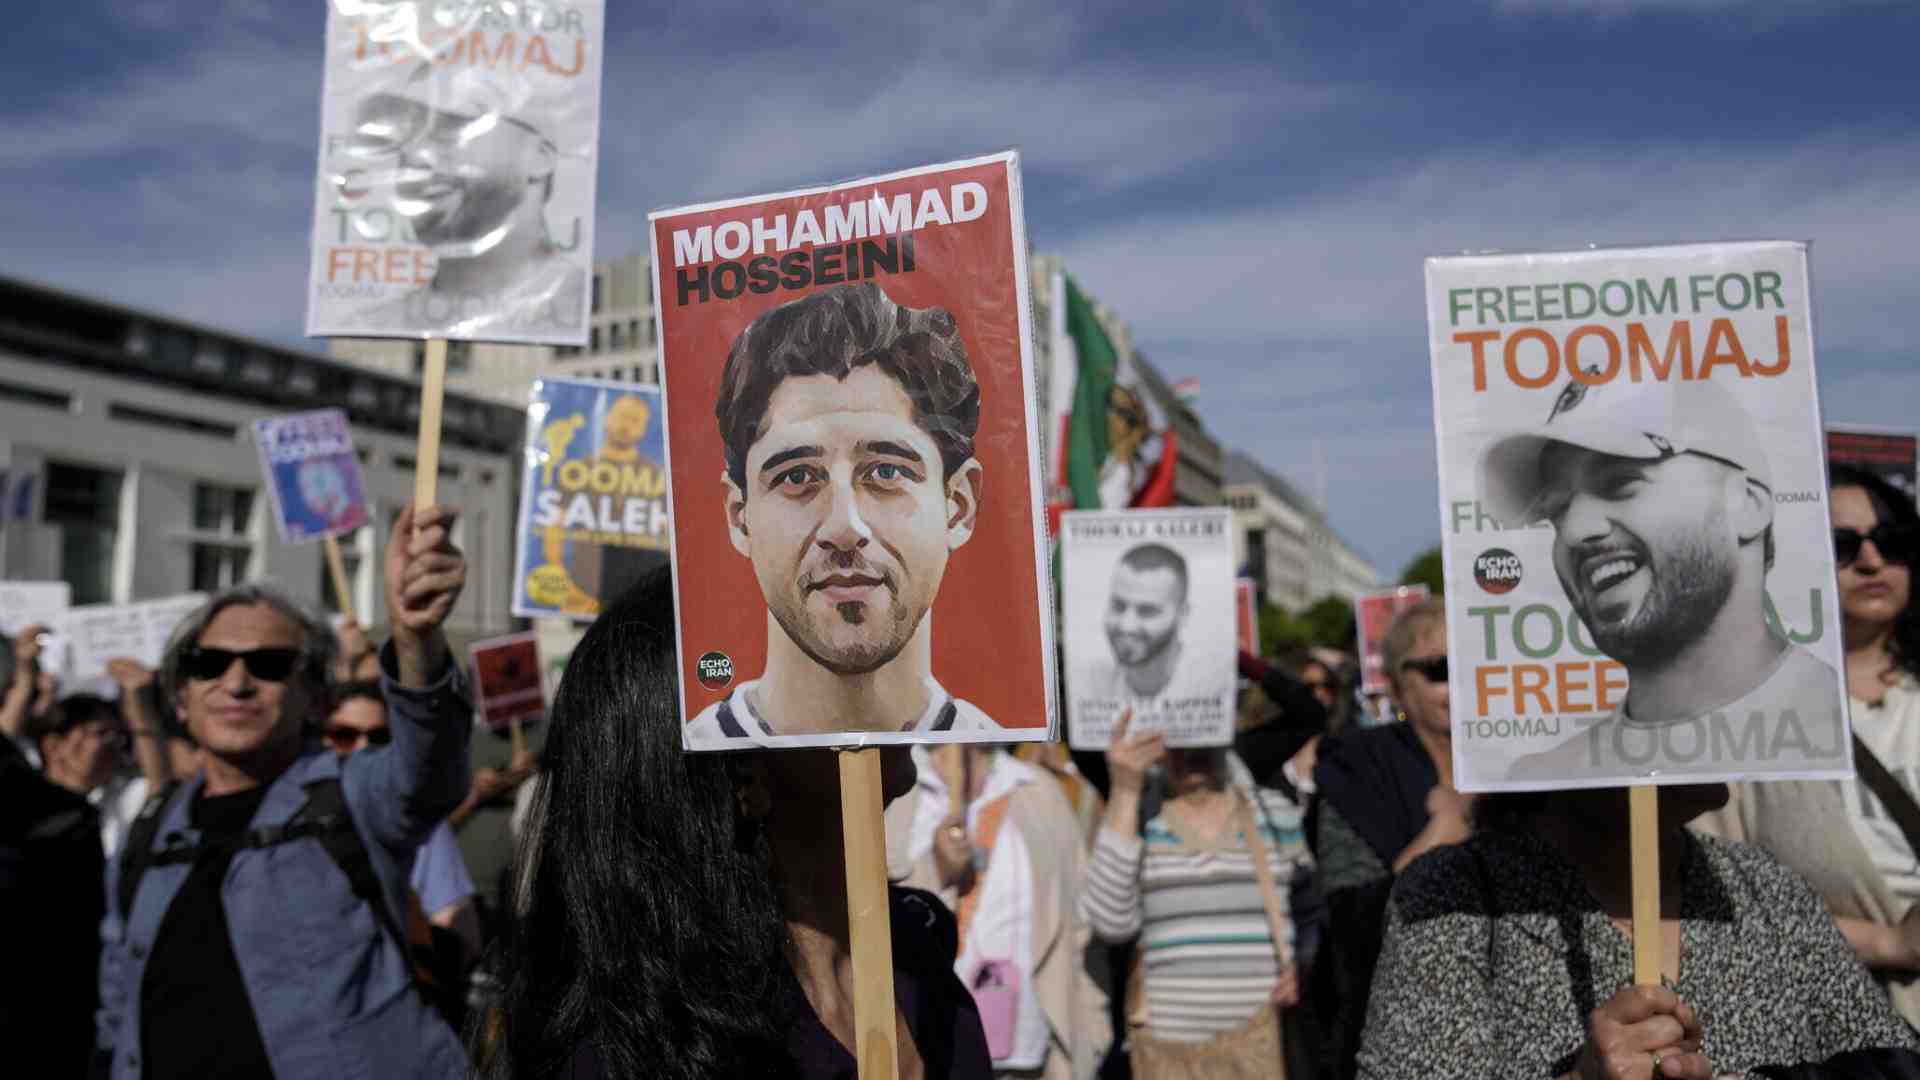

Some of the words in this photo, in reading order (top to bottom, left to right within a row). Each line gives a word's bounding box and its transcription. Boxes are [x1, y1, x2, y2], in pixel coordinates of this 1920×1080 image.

[673, 181, 988, 267] MOHAMMAD
[328, 247, 433, 285] FREE
[676, 236, 916, 306] HOSSEINI
[1448, 276, 1679, 326] FREEDOM
[1689, 271, 1785, 314] FOR
[1452, 315, 1792, 392] TOOMAJ
[1775, 490, 1821, 505] OOMAJ
[1478, 557, 1518, 570] ECHO
[1486, 567, 1521, 579] IRAN
[700, 659, 730, 669] ECHO
[706, 667, 732, 678] IRAN
[1475, 660, 1629, 717] FREE
[1461, 718, 1561, 740] TOOMAJ
[1574, 706, 1844, 768] TOOMAJ
